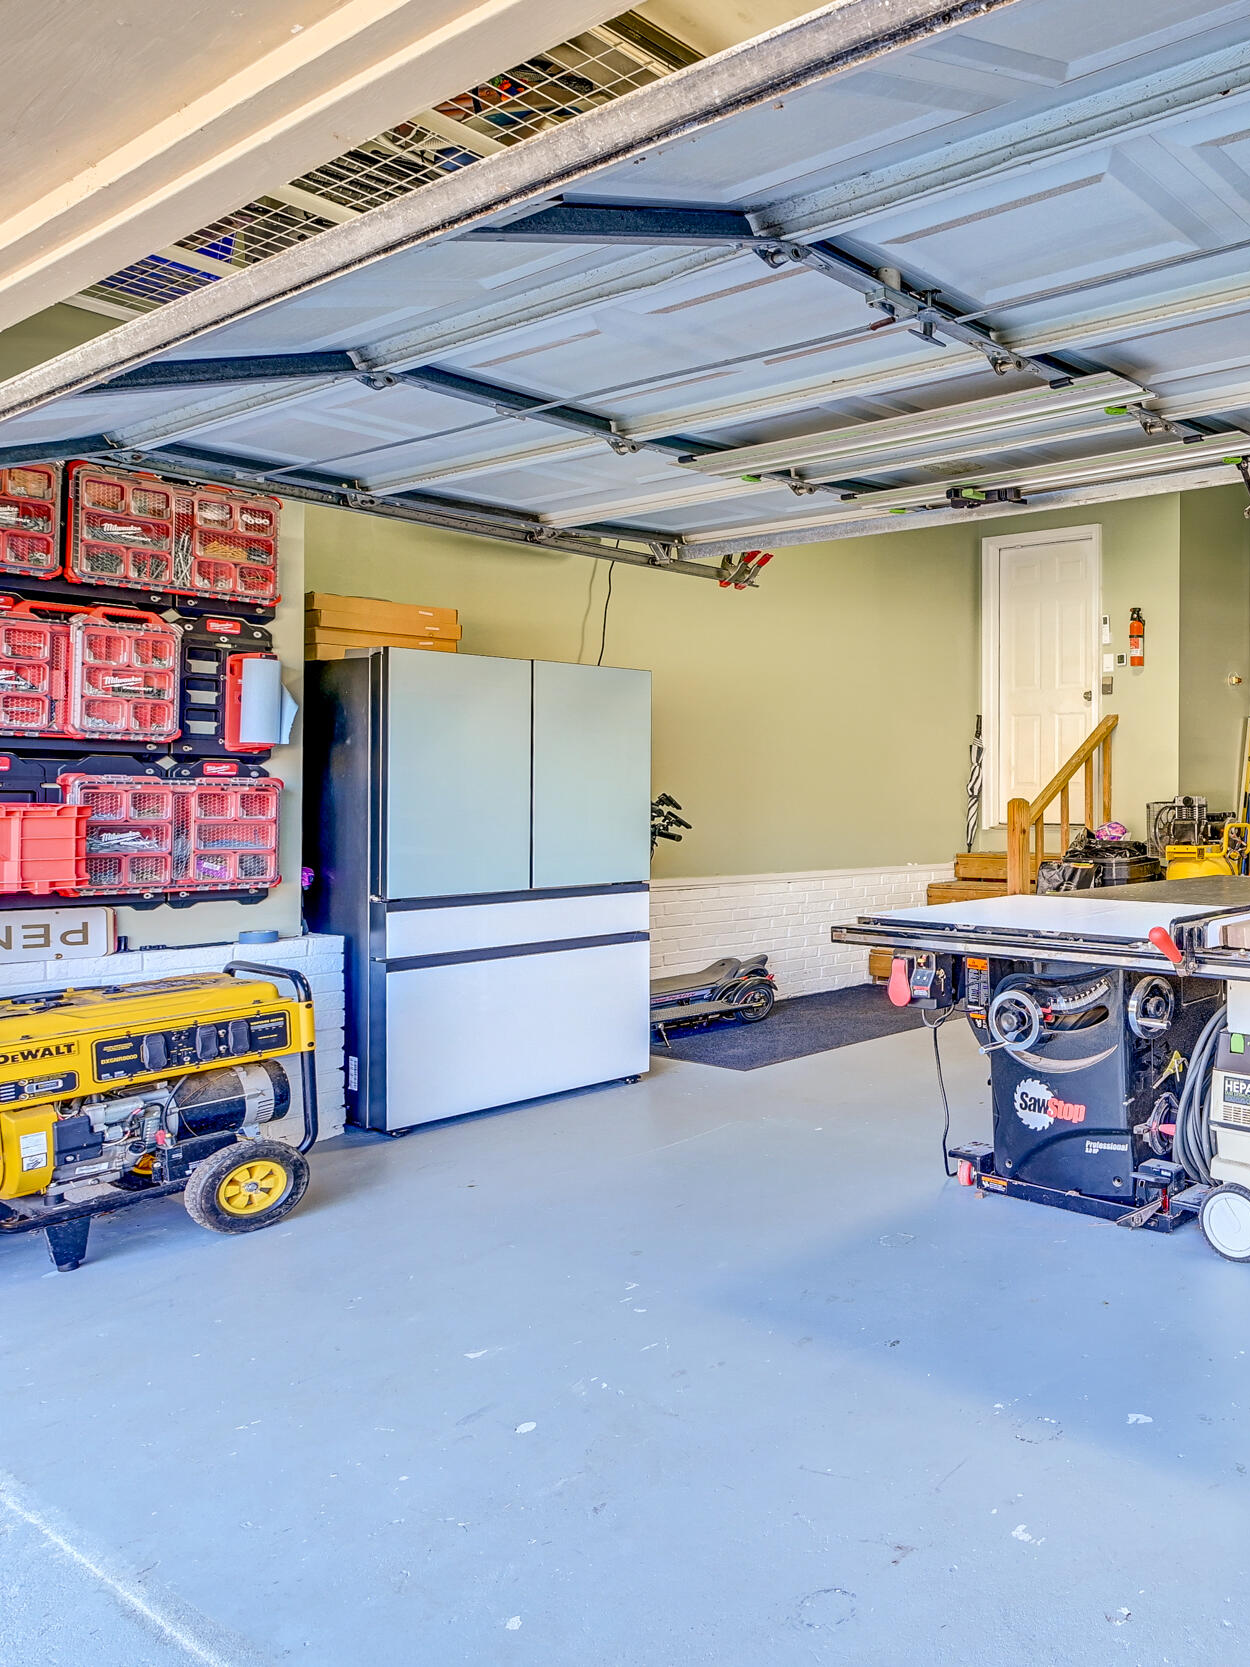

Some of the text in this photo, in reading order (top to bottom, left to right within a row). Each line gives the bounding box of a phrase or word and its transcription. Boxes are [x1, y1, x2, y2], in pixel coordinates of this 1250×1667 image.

[101, 522, 143, 532] Milwaukee
[102, 675, 143, 685] Milwaukee
[100, 830, 142, 842] Milwaukee
[1019, 1091, 1086, 1124] SawStop
[1084, 1139, 1129, 1152] Professional
